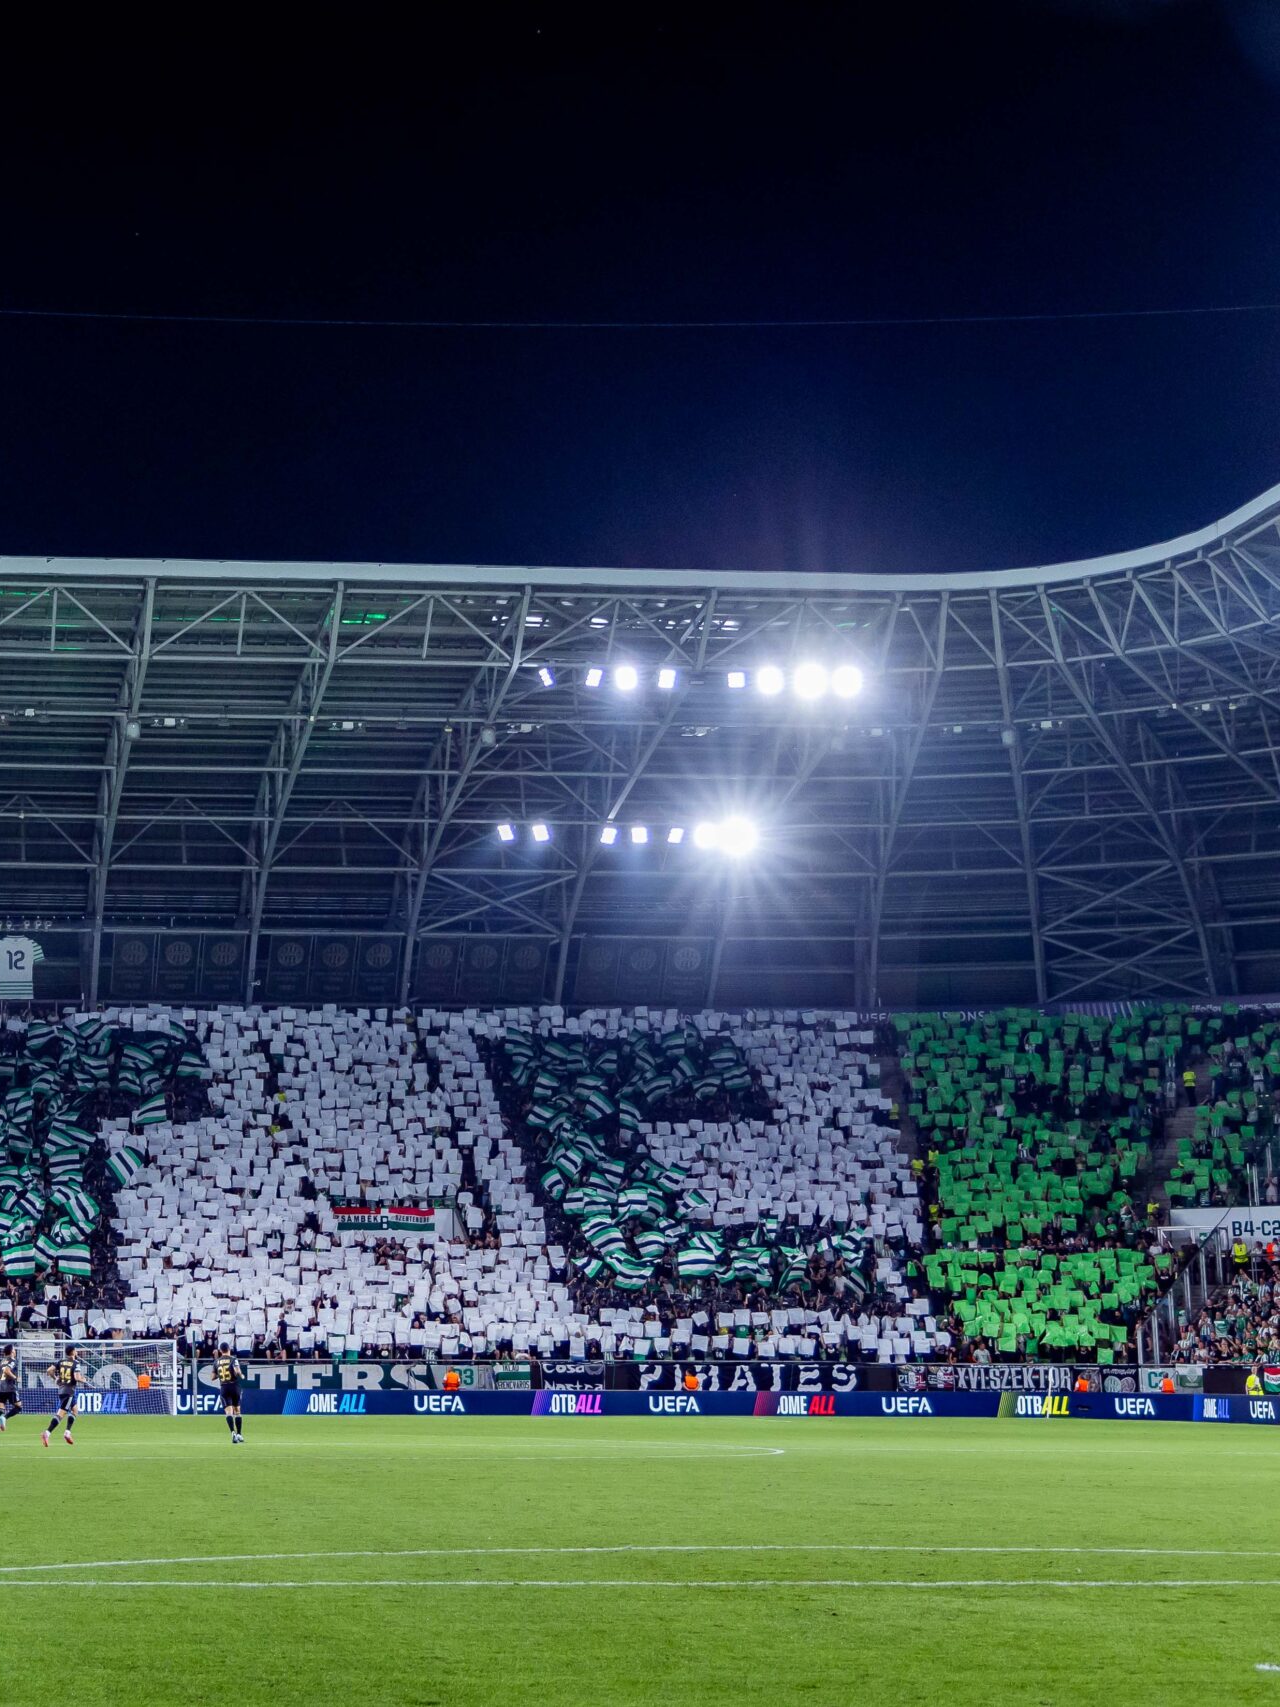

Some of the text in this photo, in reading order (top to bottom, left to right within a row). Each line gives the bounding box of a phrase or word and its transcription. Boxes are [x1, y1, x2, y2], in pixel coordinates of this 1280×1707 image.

[6, 950, 26, 970] 12
[1232, 1220, 1280, 1236] B4-C2
[217, 1366, 232, 1382] 35
[543, 1363, 585, 1374] Cosa
[76, 1393, 127, 1412] OTBALL
[307, 1394, 366, 1412] OME ALL
[414, 1395, 465, 1412] UEFA
[549, 1394, 602, 1413] OTBALL
[649, 1396, 700, 1413] UEFA
[777, 1395, 835, 1414] OME ALL
[881, 1397, 932, 1413] UEFA
[1015, 1396, 1070, 1415] OTBALL
[1115, 1398, 1155, 1415] UEFA
[1203, 1399, 1229, 1418] OME ALL
[1249, 1401, 1275, 1419] UEFA
